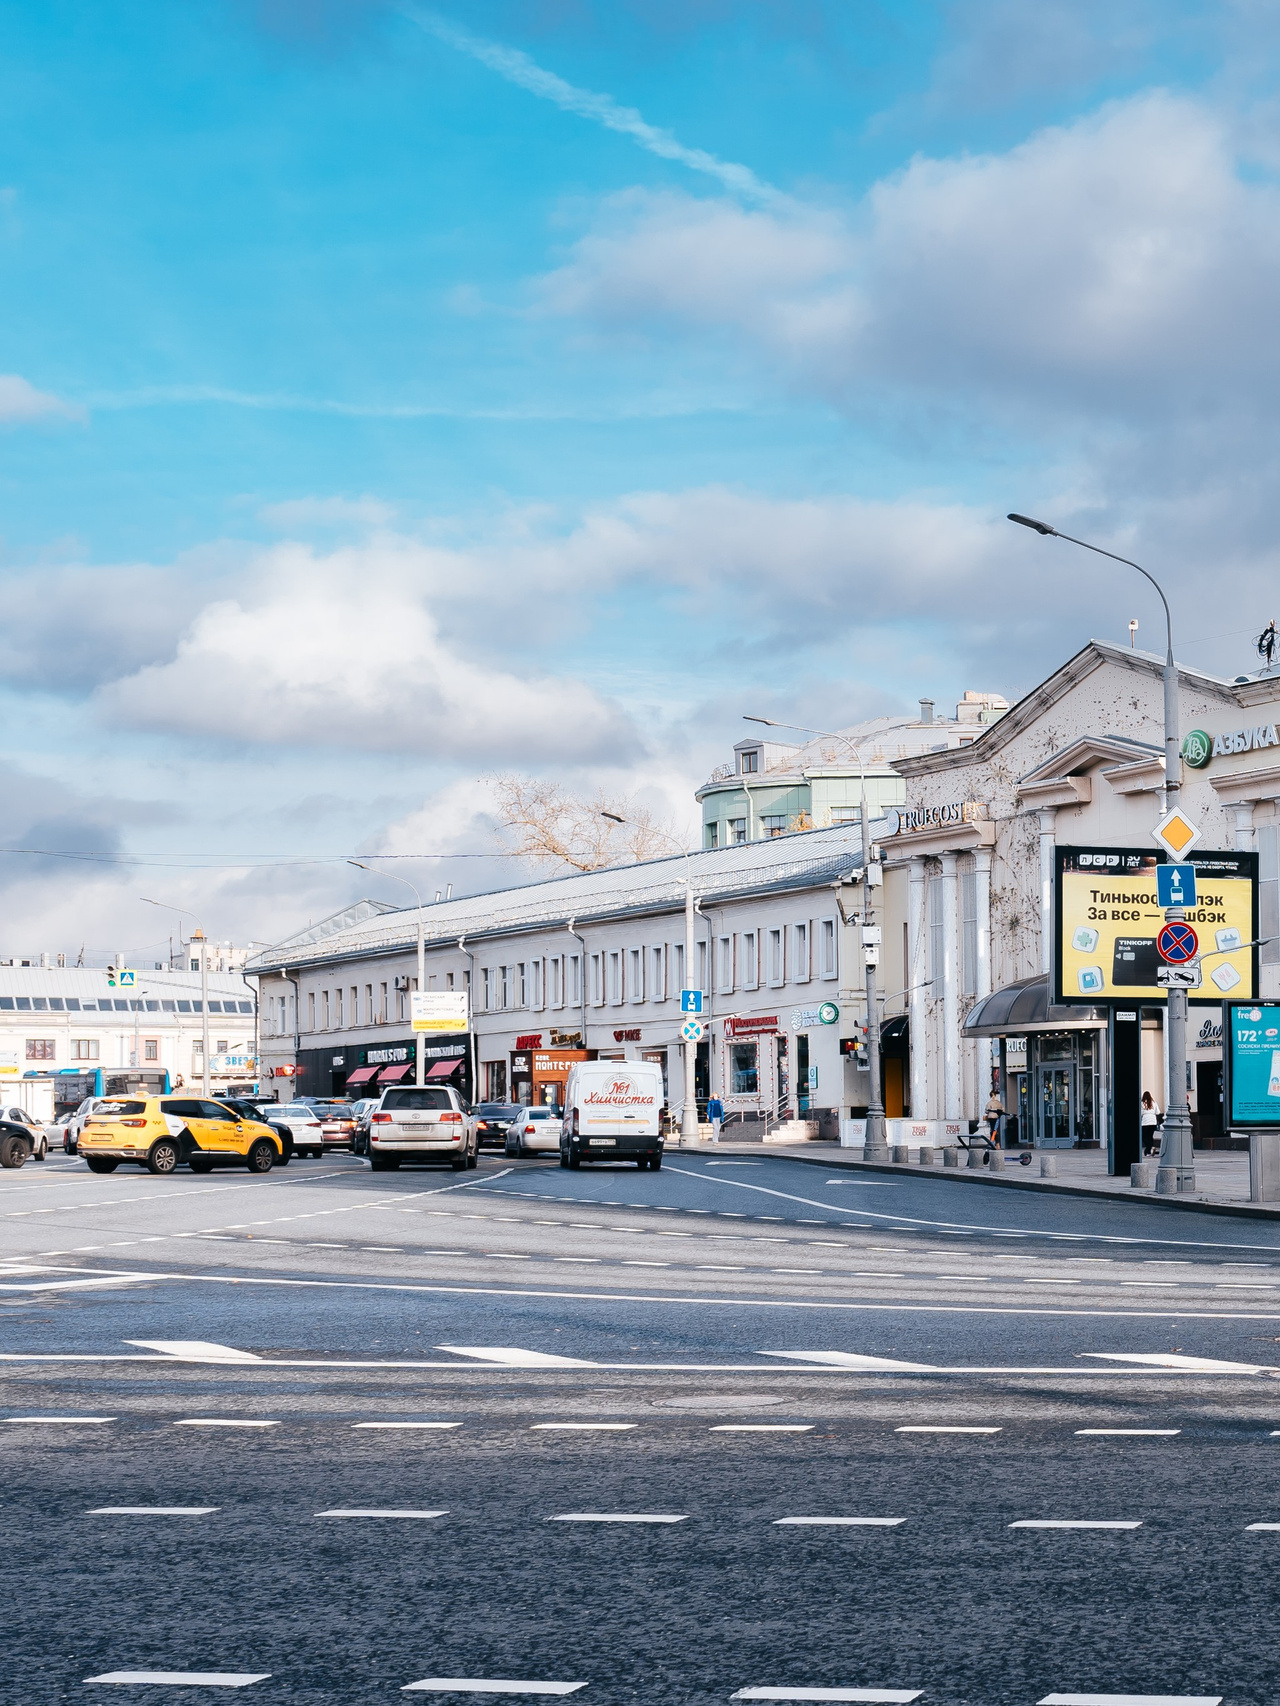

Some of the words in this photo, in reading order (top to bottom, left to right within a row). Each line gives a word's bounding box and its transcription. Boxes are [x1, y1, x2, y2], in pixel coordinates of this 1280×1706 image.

[1211, 722, 1280, 757] АЗБУКА
[1089, 890, 1159, 907] Тинько
[1195, 894, 1224, 907] лэк
[1087, 906, 1107, 921] За
[1111, 909, 1140, 921] все
[1165, 908, 1226, 923] шбэк
[1237, 1010, 1258, 1020] fresh
[608, 1081, 631, 1095] №1
[583, 1091, 655, 1104] Химчистка
